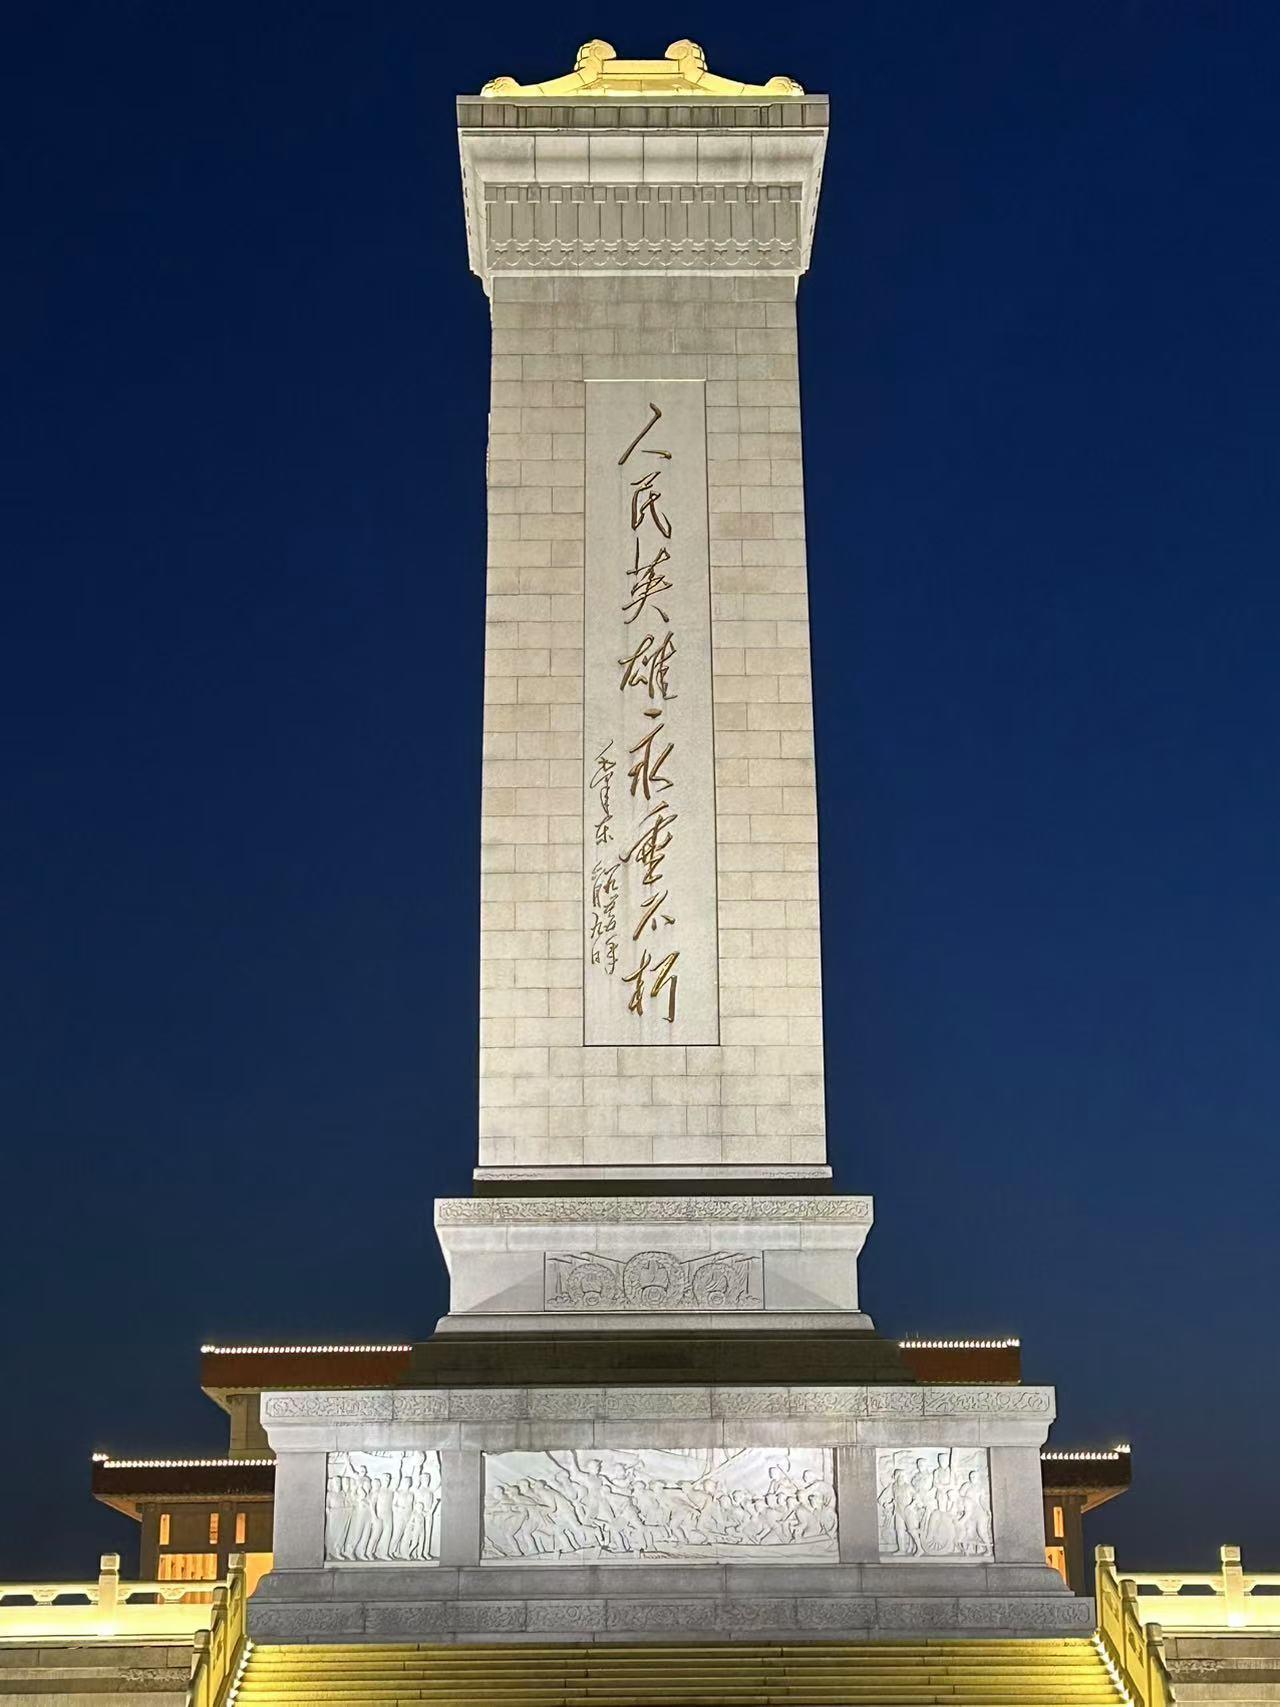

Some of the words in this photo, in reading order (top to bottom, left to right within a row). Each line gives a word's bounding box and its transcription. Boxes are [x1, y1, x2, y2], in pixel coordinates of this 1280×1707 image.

[618, 402, 680, 1023] 人民英雄永垂不朽
